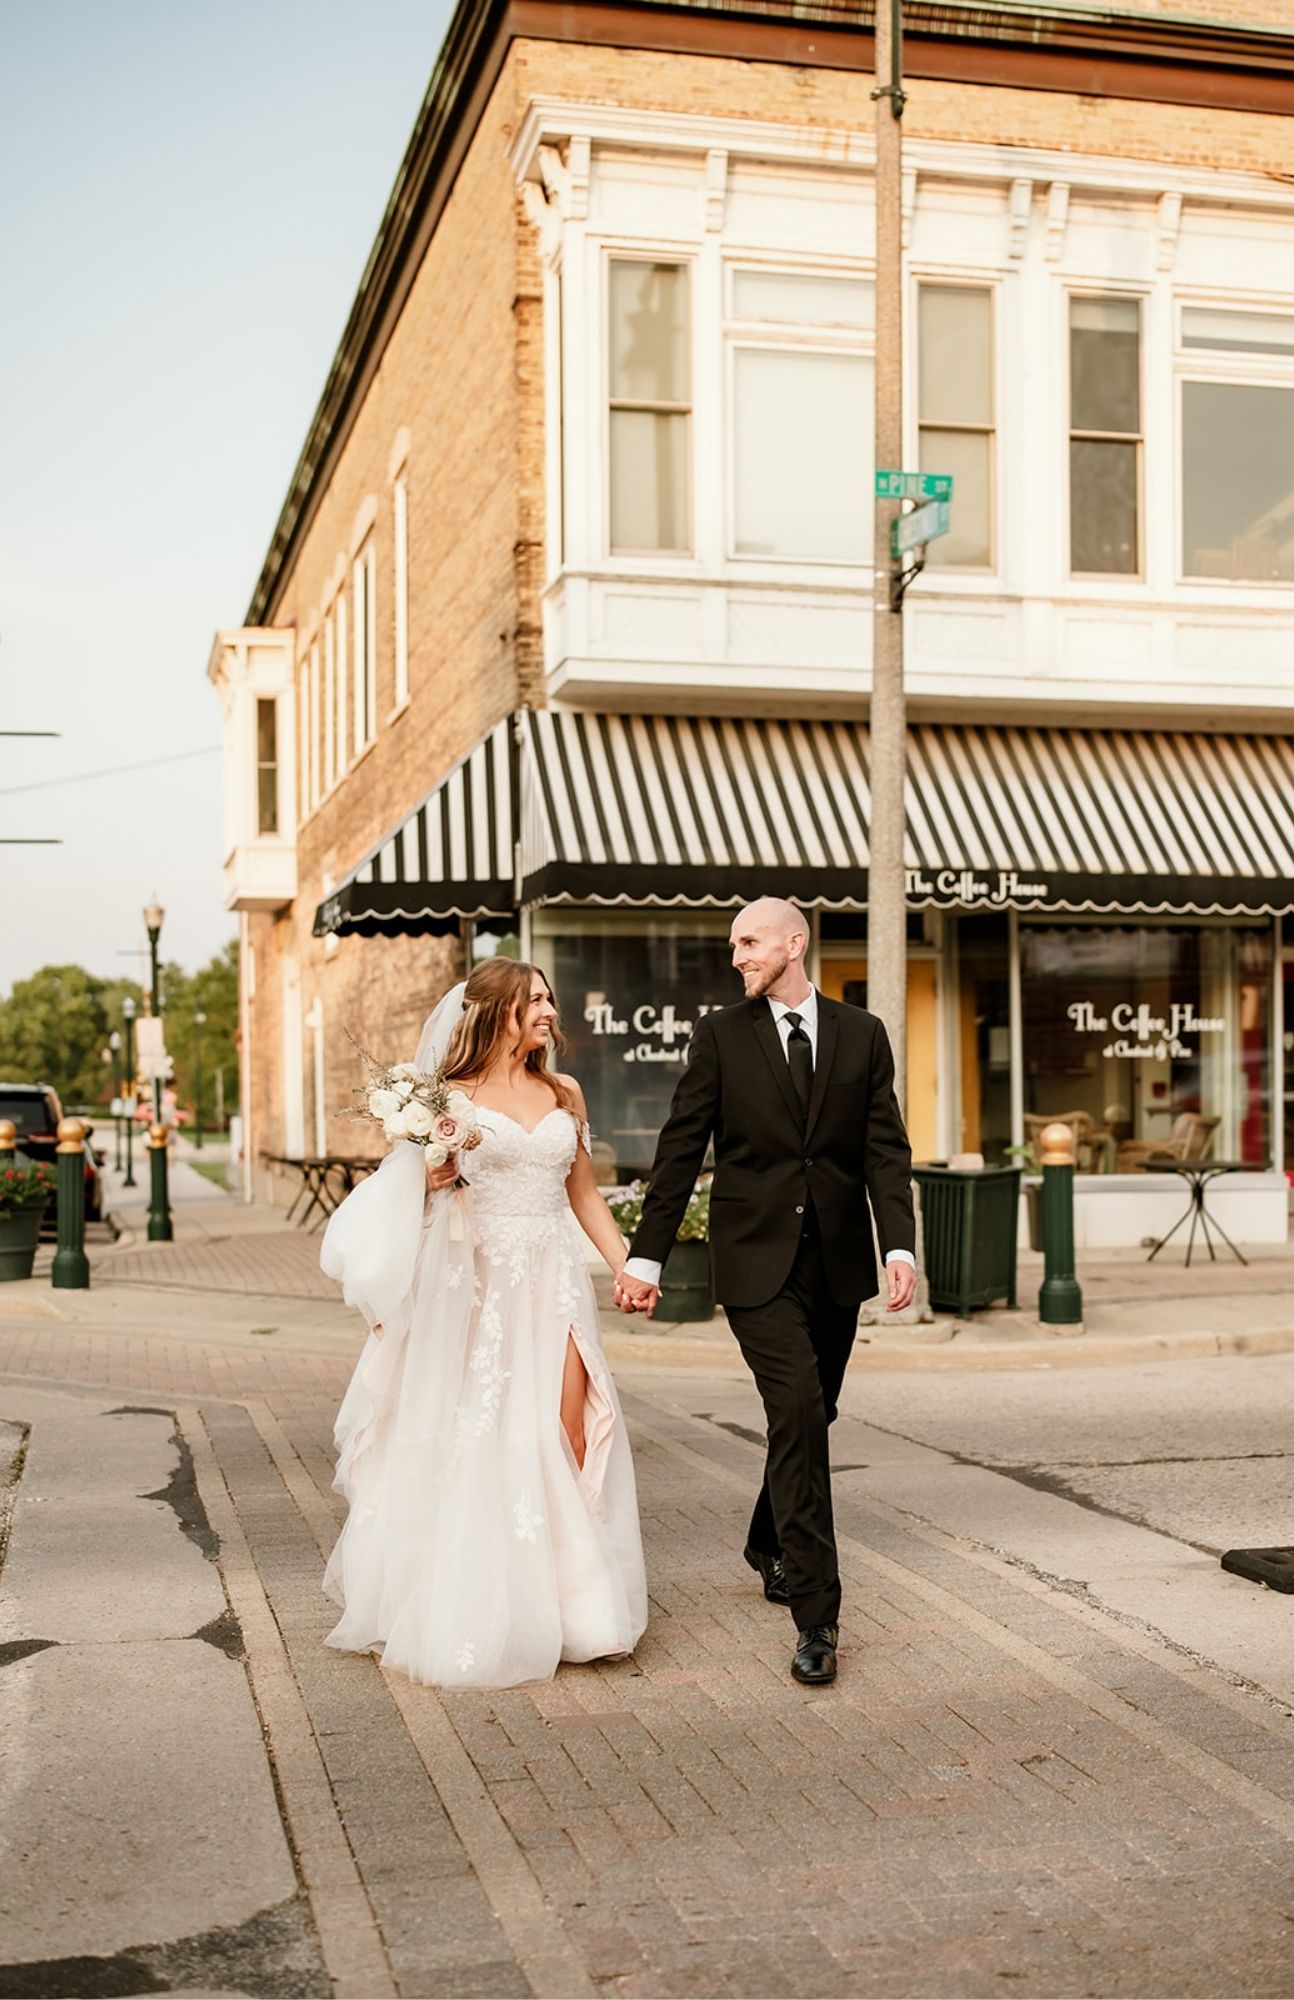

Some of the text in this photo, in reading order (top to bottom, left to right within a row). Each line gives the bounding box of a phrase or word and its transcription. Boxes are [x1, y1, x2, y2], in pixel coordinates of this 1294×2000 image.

[889, 473, 927, 496] PINE
[904, 870, 1048, 903] The Coffee House
[584, 1003, 629, 1035] The
[633, 1005, 693, 1043] Coffee
[1067, 1001, 1226, 1041] The Coffee House
